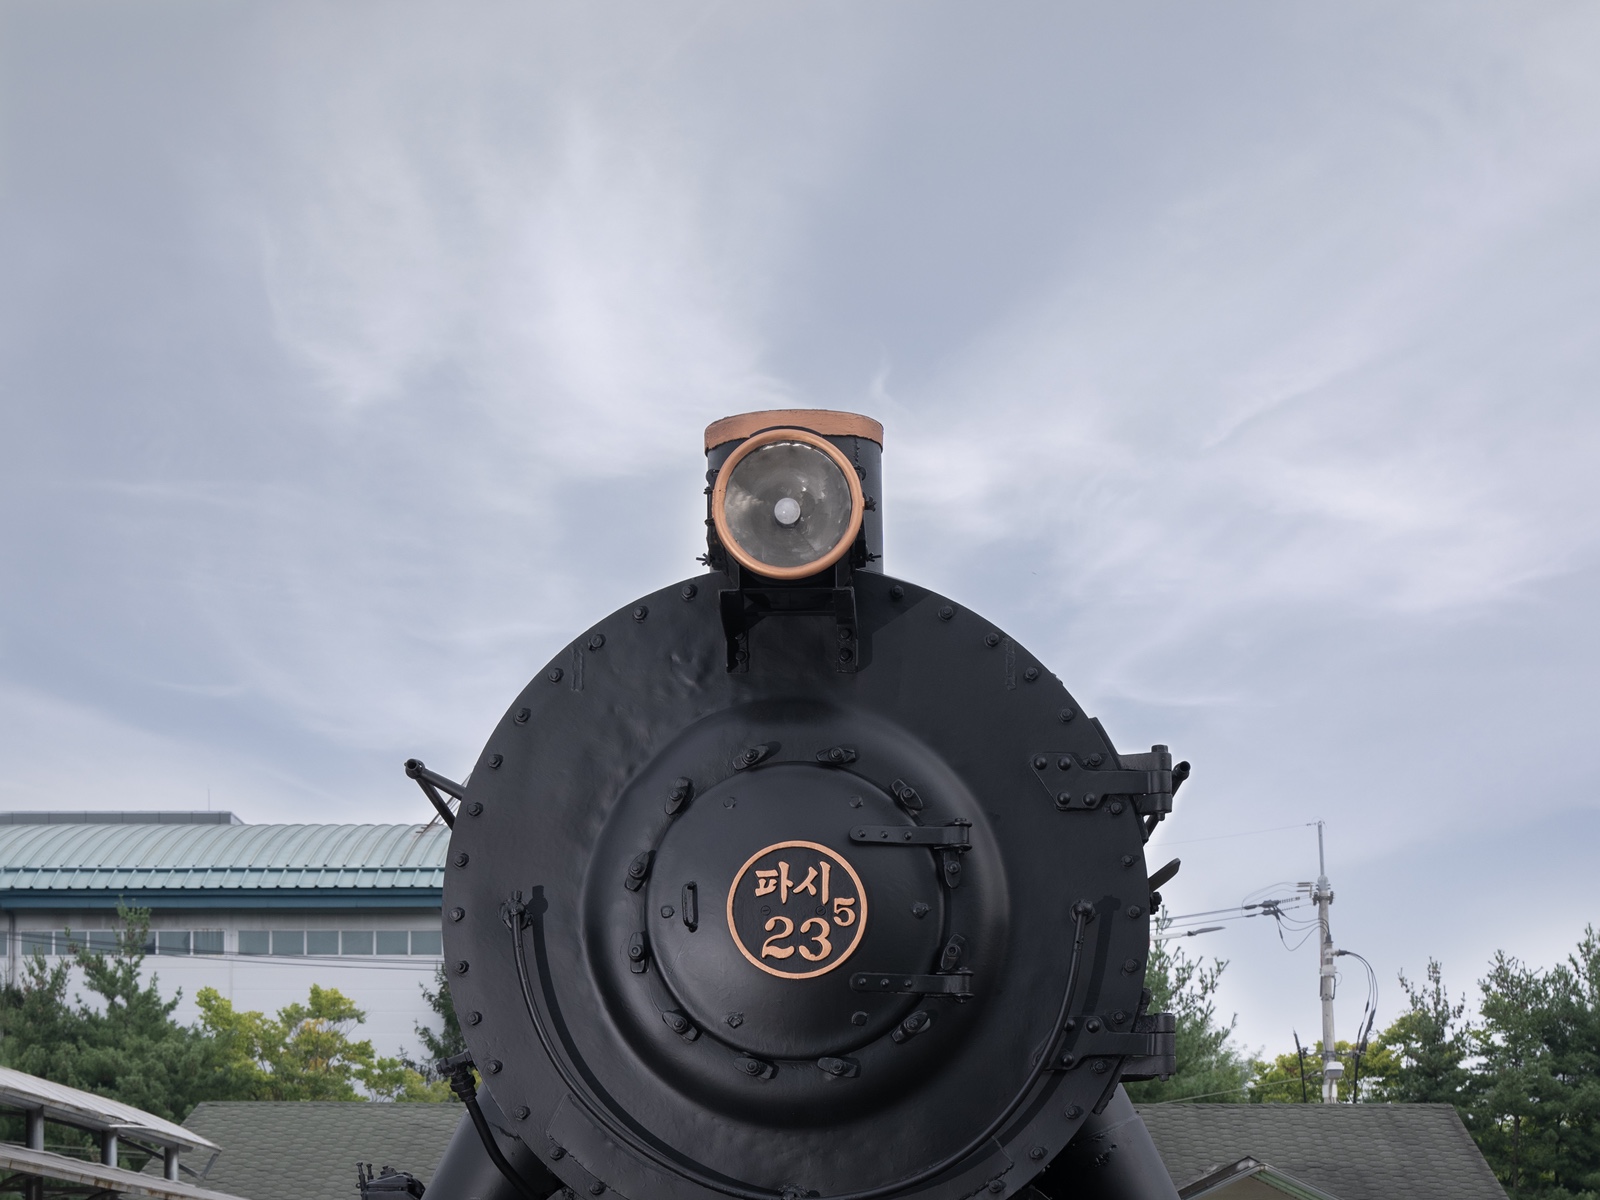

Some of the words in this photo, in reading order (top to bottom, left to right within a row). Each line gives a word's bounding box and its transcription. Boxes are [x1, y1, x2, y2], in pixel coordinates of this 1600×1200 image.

[755, 861, 831, 905] 파시
[834, 897, 856, 927] 5
[761, 916, 832, 961] 23
